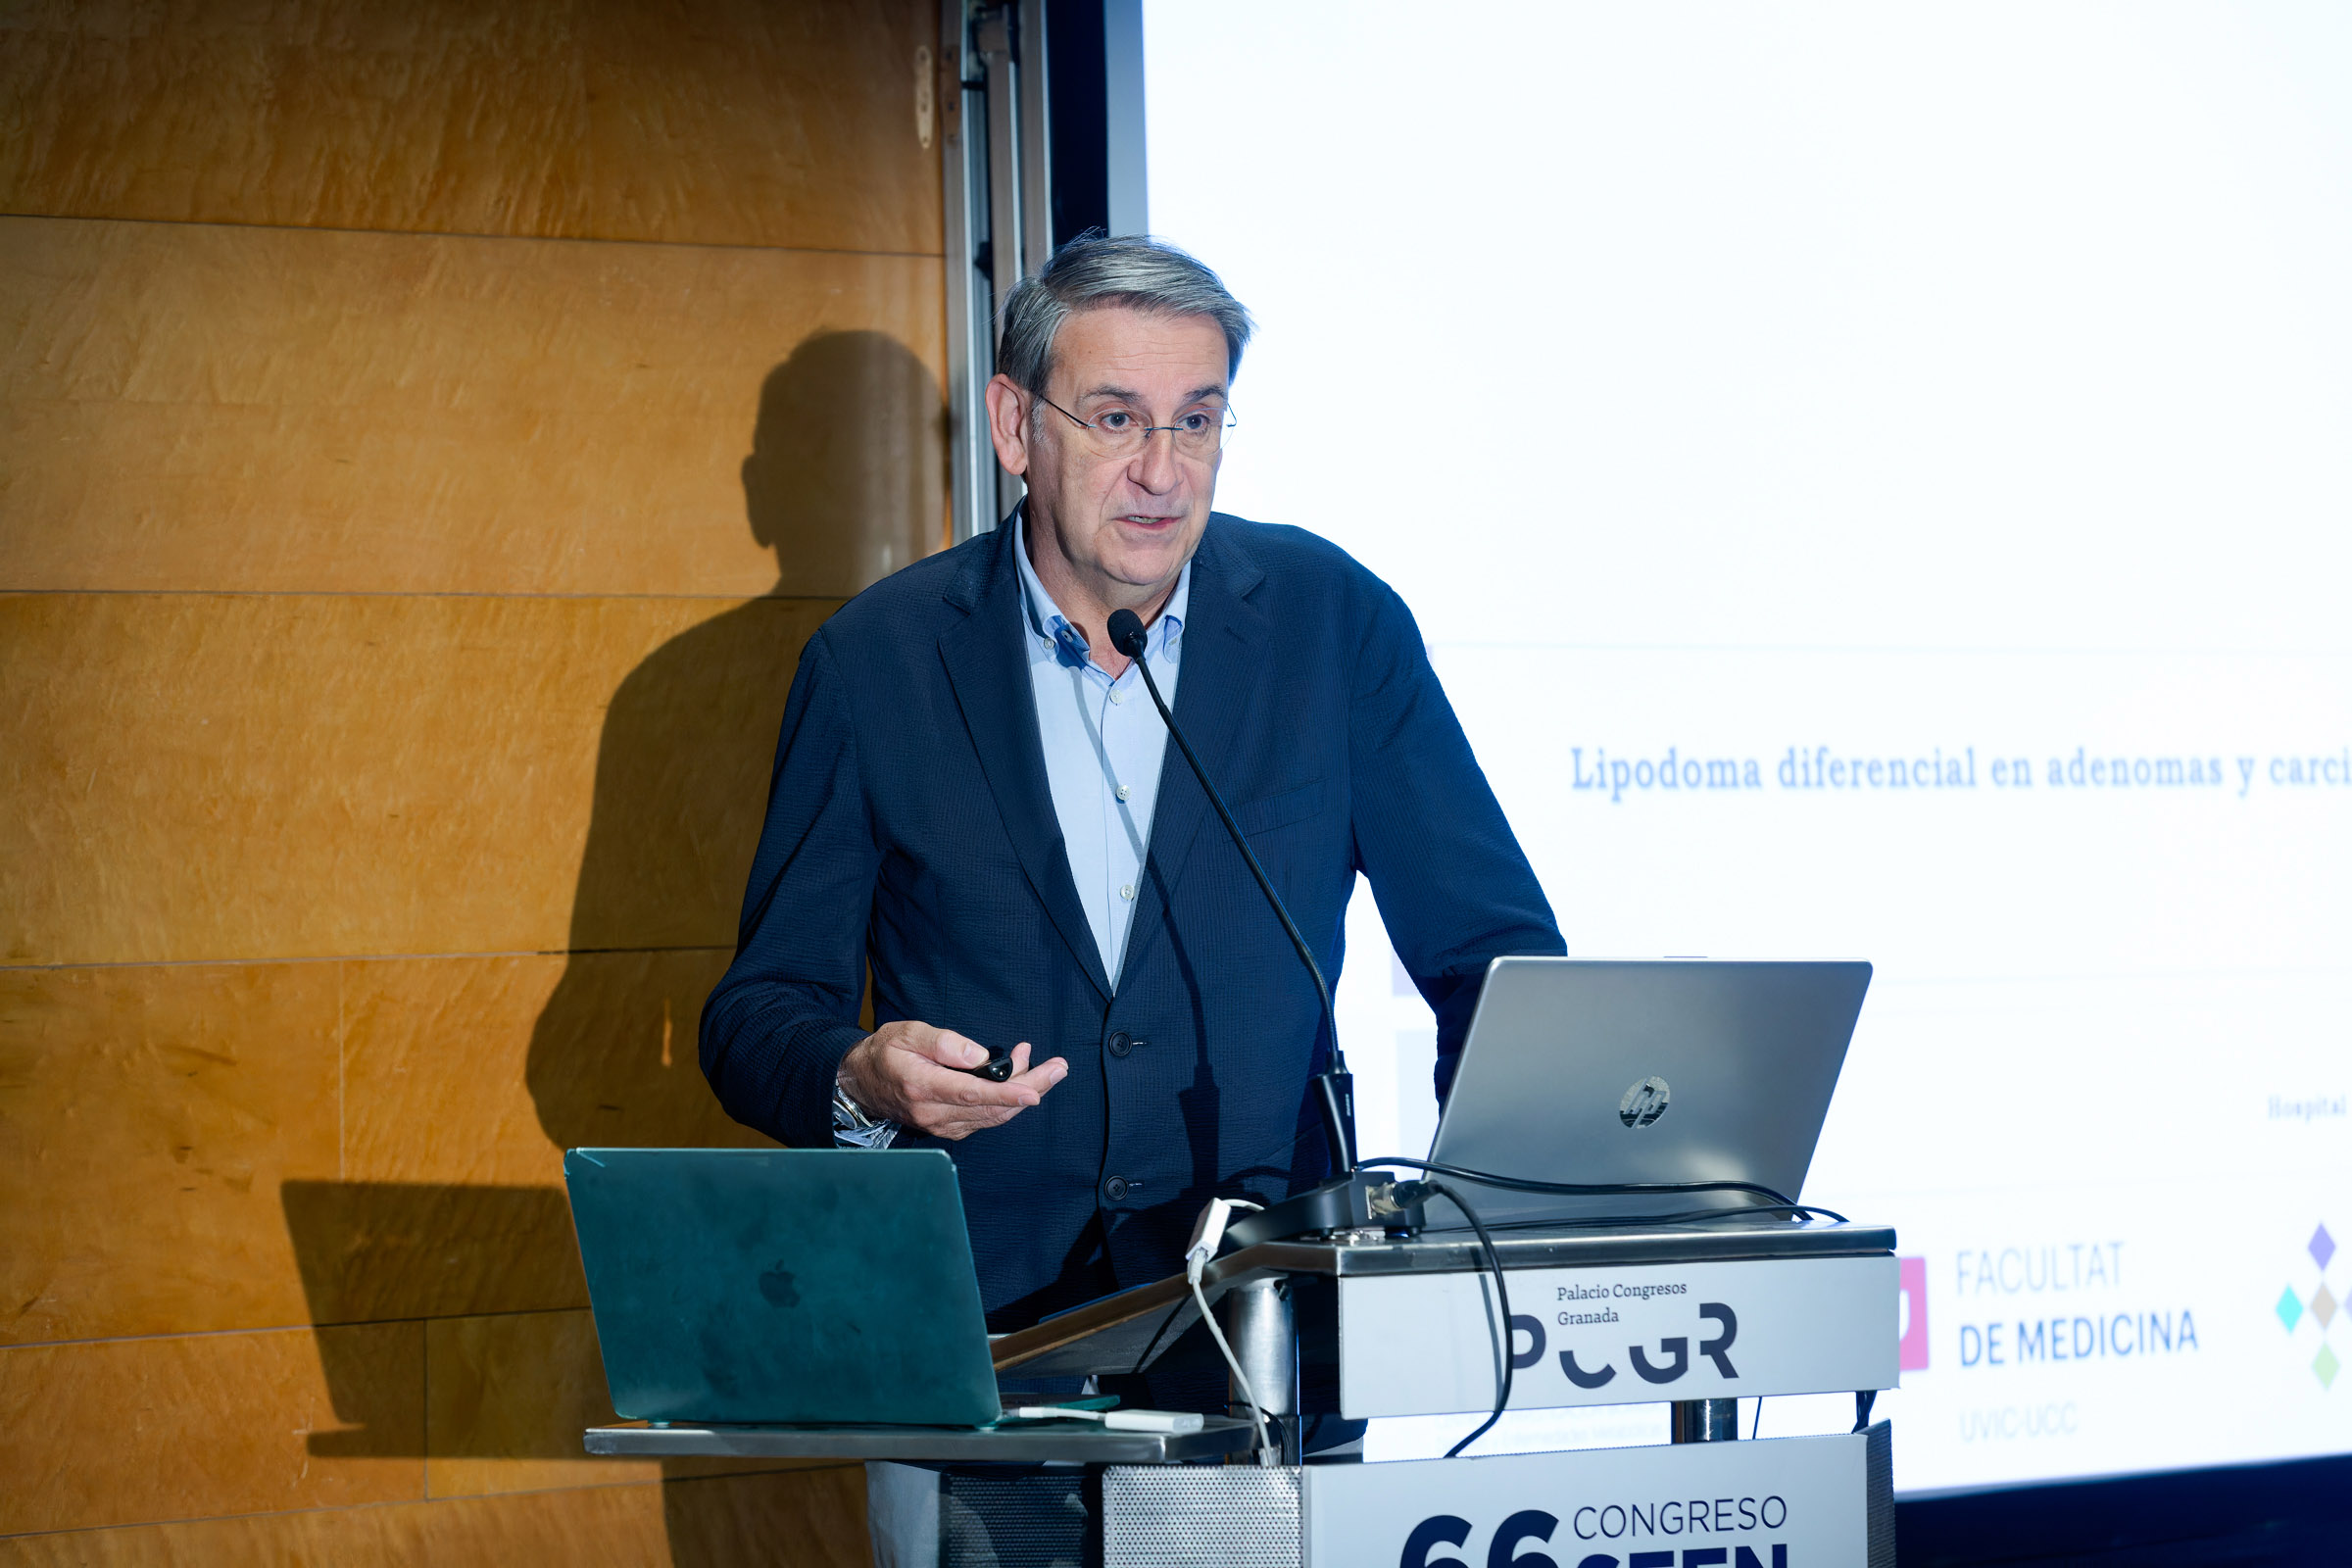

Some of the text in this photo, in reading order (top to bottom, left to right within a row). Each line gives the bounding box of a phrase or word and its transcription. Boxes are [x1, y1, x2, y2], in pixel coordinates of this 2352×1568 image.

[1570, 746, 1762, 804] Lipodoma
[1777, 745, 1977, 789] diferencial
[1991, 756, 2033, 787] en
[2047, 746, 2223, 787] adenomas
[2237, 757, 2255, 800] y
[1557, 1283, 1688, 1300] Palacio Congresos
[1956, 1239, 2126, 1297] FACULTAT
[1557, 1307, 1620, 1326] Granada
[1960, 1307, 2198, 1368] DE MEDICINA
[1573, 1495, 1788, 1540] CONGRESO
